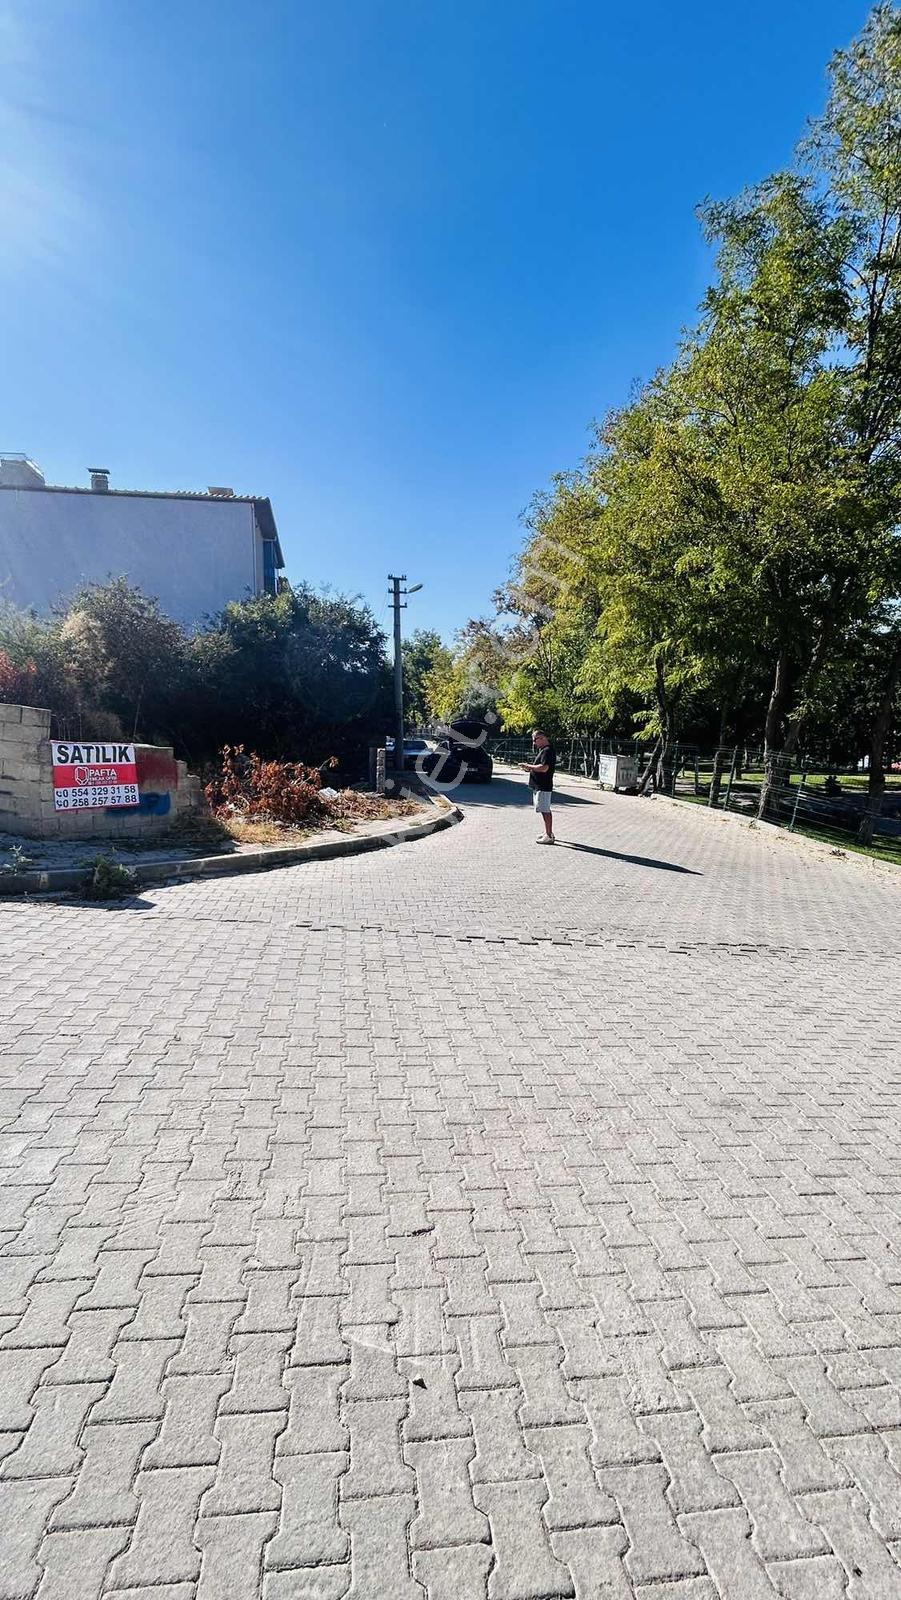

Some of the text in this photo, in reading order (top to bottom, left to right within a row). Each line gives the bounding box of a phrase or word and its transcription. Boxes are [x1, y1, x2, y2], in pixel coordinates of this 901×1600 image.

[56, 744, 131, 764] SATILIK
[89, 769, 117, 777] PAFTA
[62, 785, 136, 798] 0 554 329 31 58
[62, 794, 137, 808] 0 258 257 57 88
